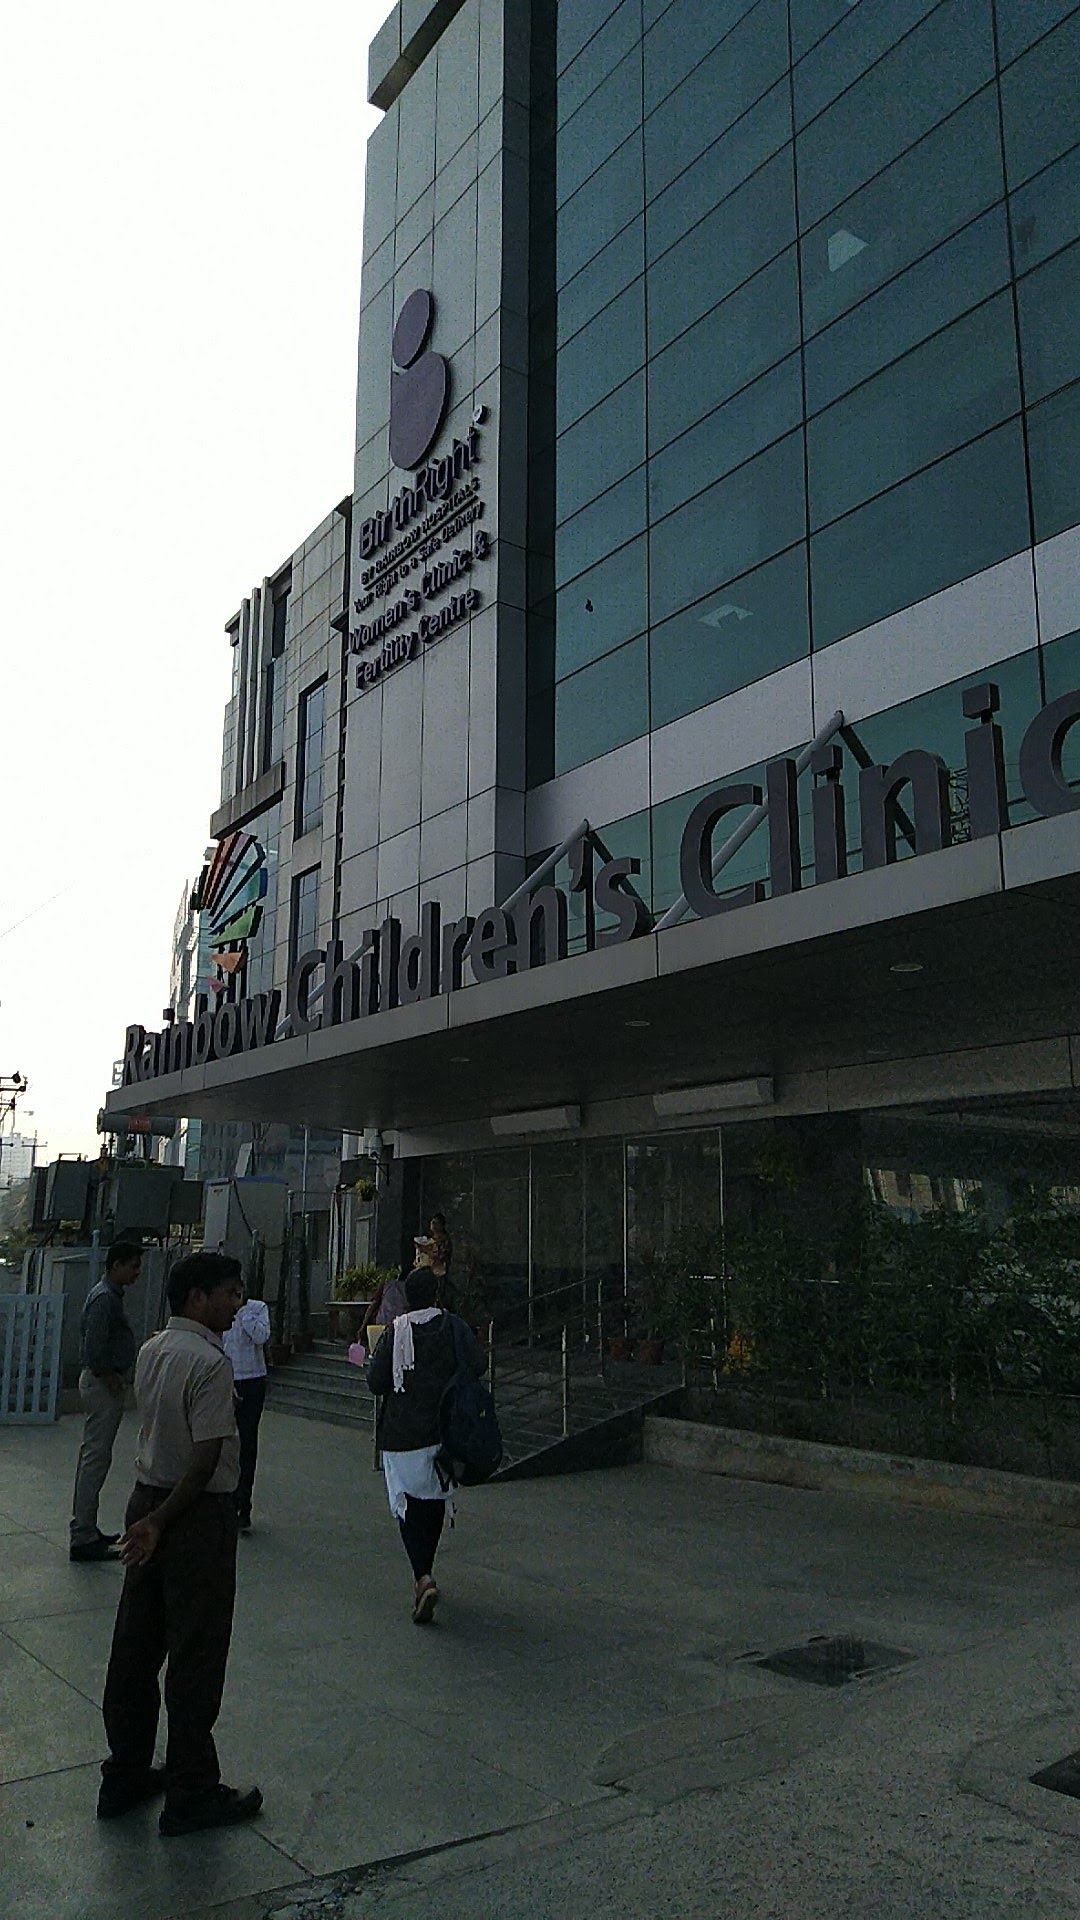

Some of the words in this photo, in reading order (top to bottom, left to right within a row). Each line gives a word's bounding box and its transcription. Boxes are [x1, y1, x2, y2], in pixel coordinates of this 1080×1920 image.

[359, 427, 478, 559] BirthRight
[349, 588, 421, 654] Women's
[422, 549, 472, 599] Clinic
[474, 530, 490, 561] &
[356, 631, 418, 689] Fertility
[418, 588, 480, 643] Centre
[123, 989, 281, 1086] Rainbow
[288, 836, 641, 1035] Children's
